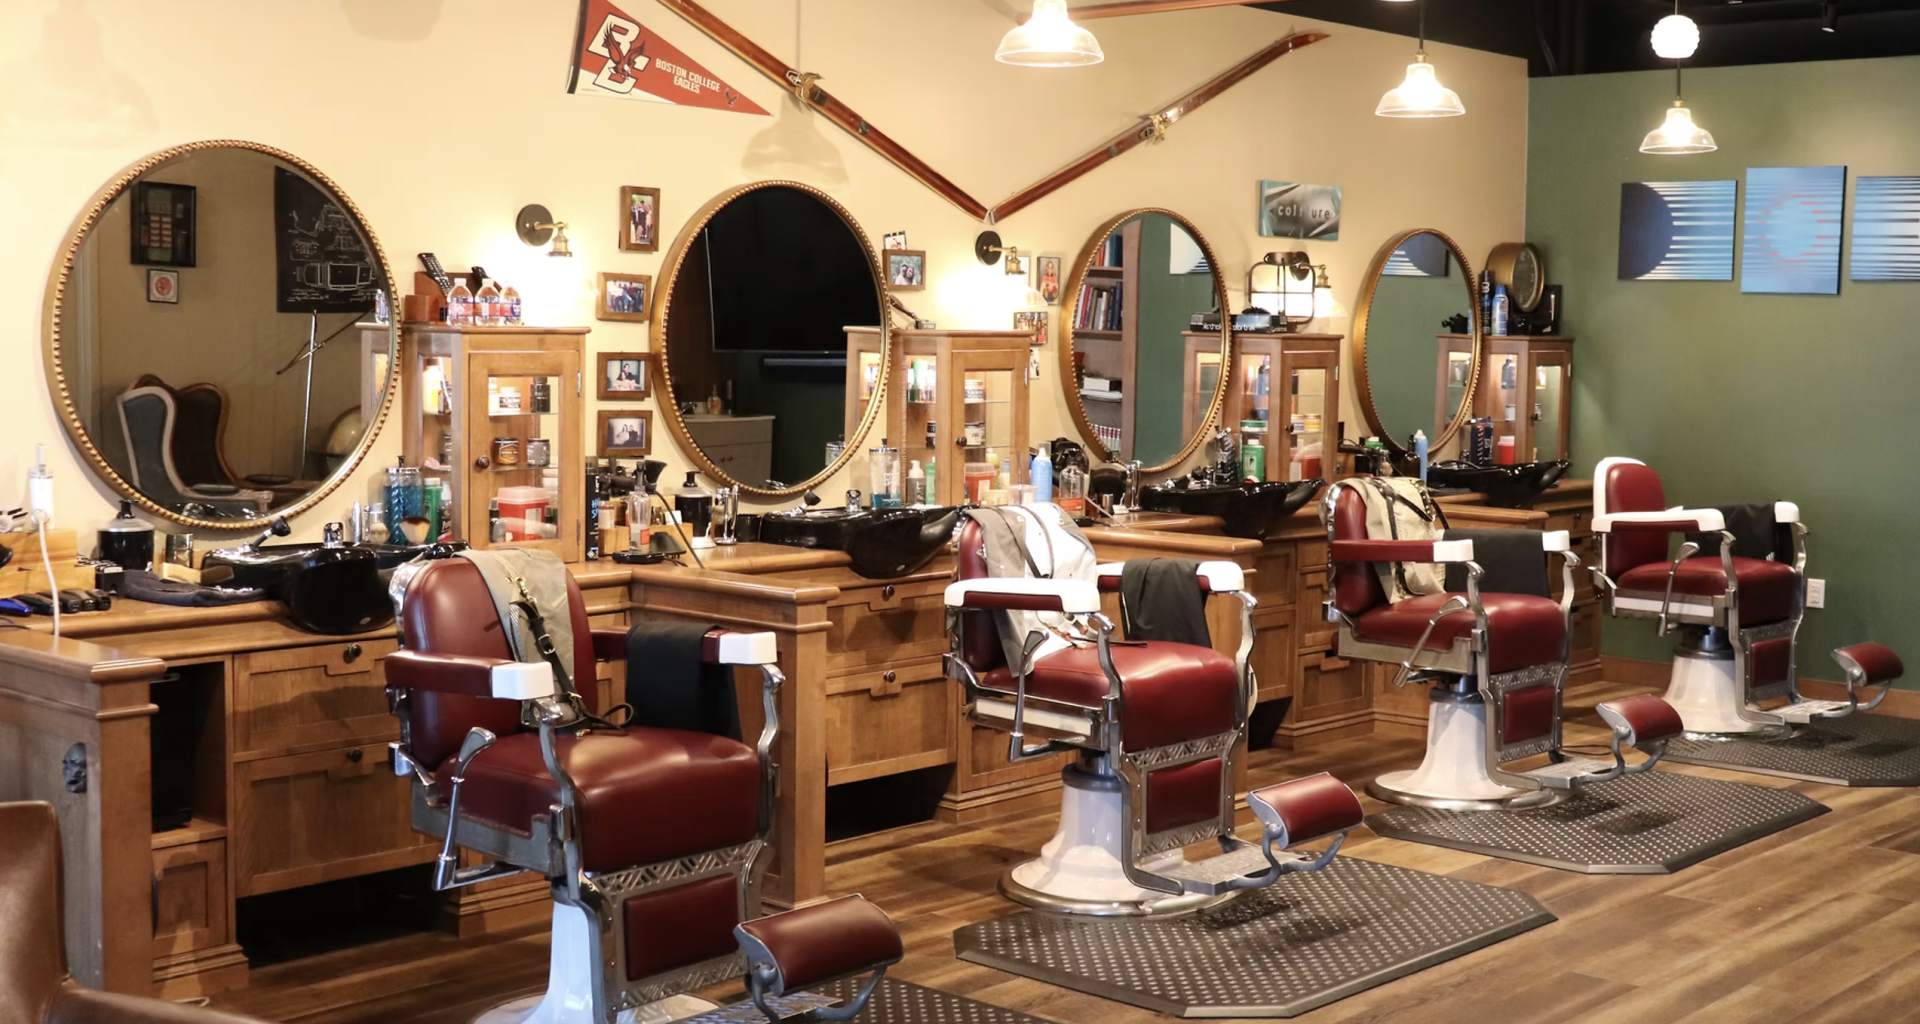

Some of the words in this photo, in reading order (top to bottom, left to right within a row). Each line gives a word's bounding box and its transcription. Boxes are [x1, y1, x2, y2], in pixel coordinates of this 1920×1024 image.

[655, 58, 687, 78] BOSTON
[688, 71, 721, 92] COLLEGE
[673, 75, 700, 93] EAGLES
